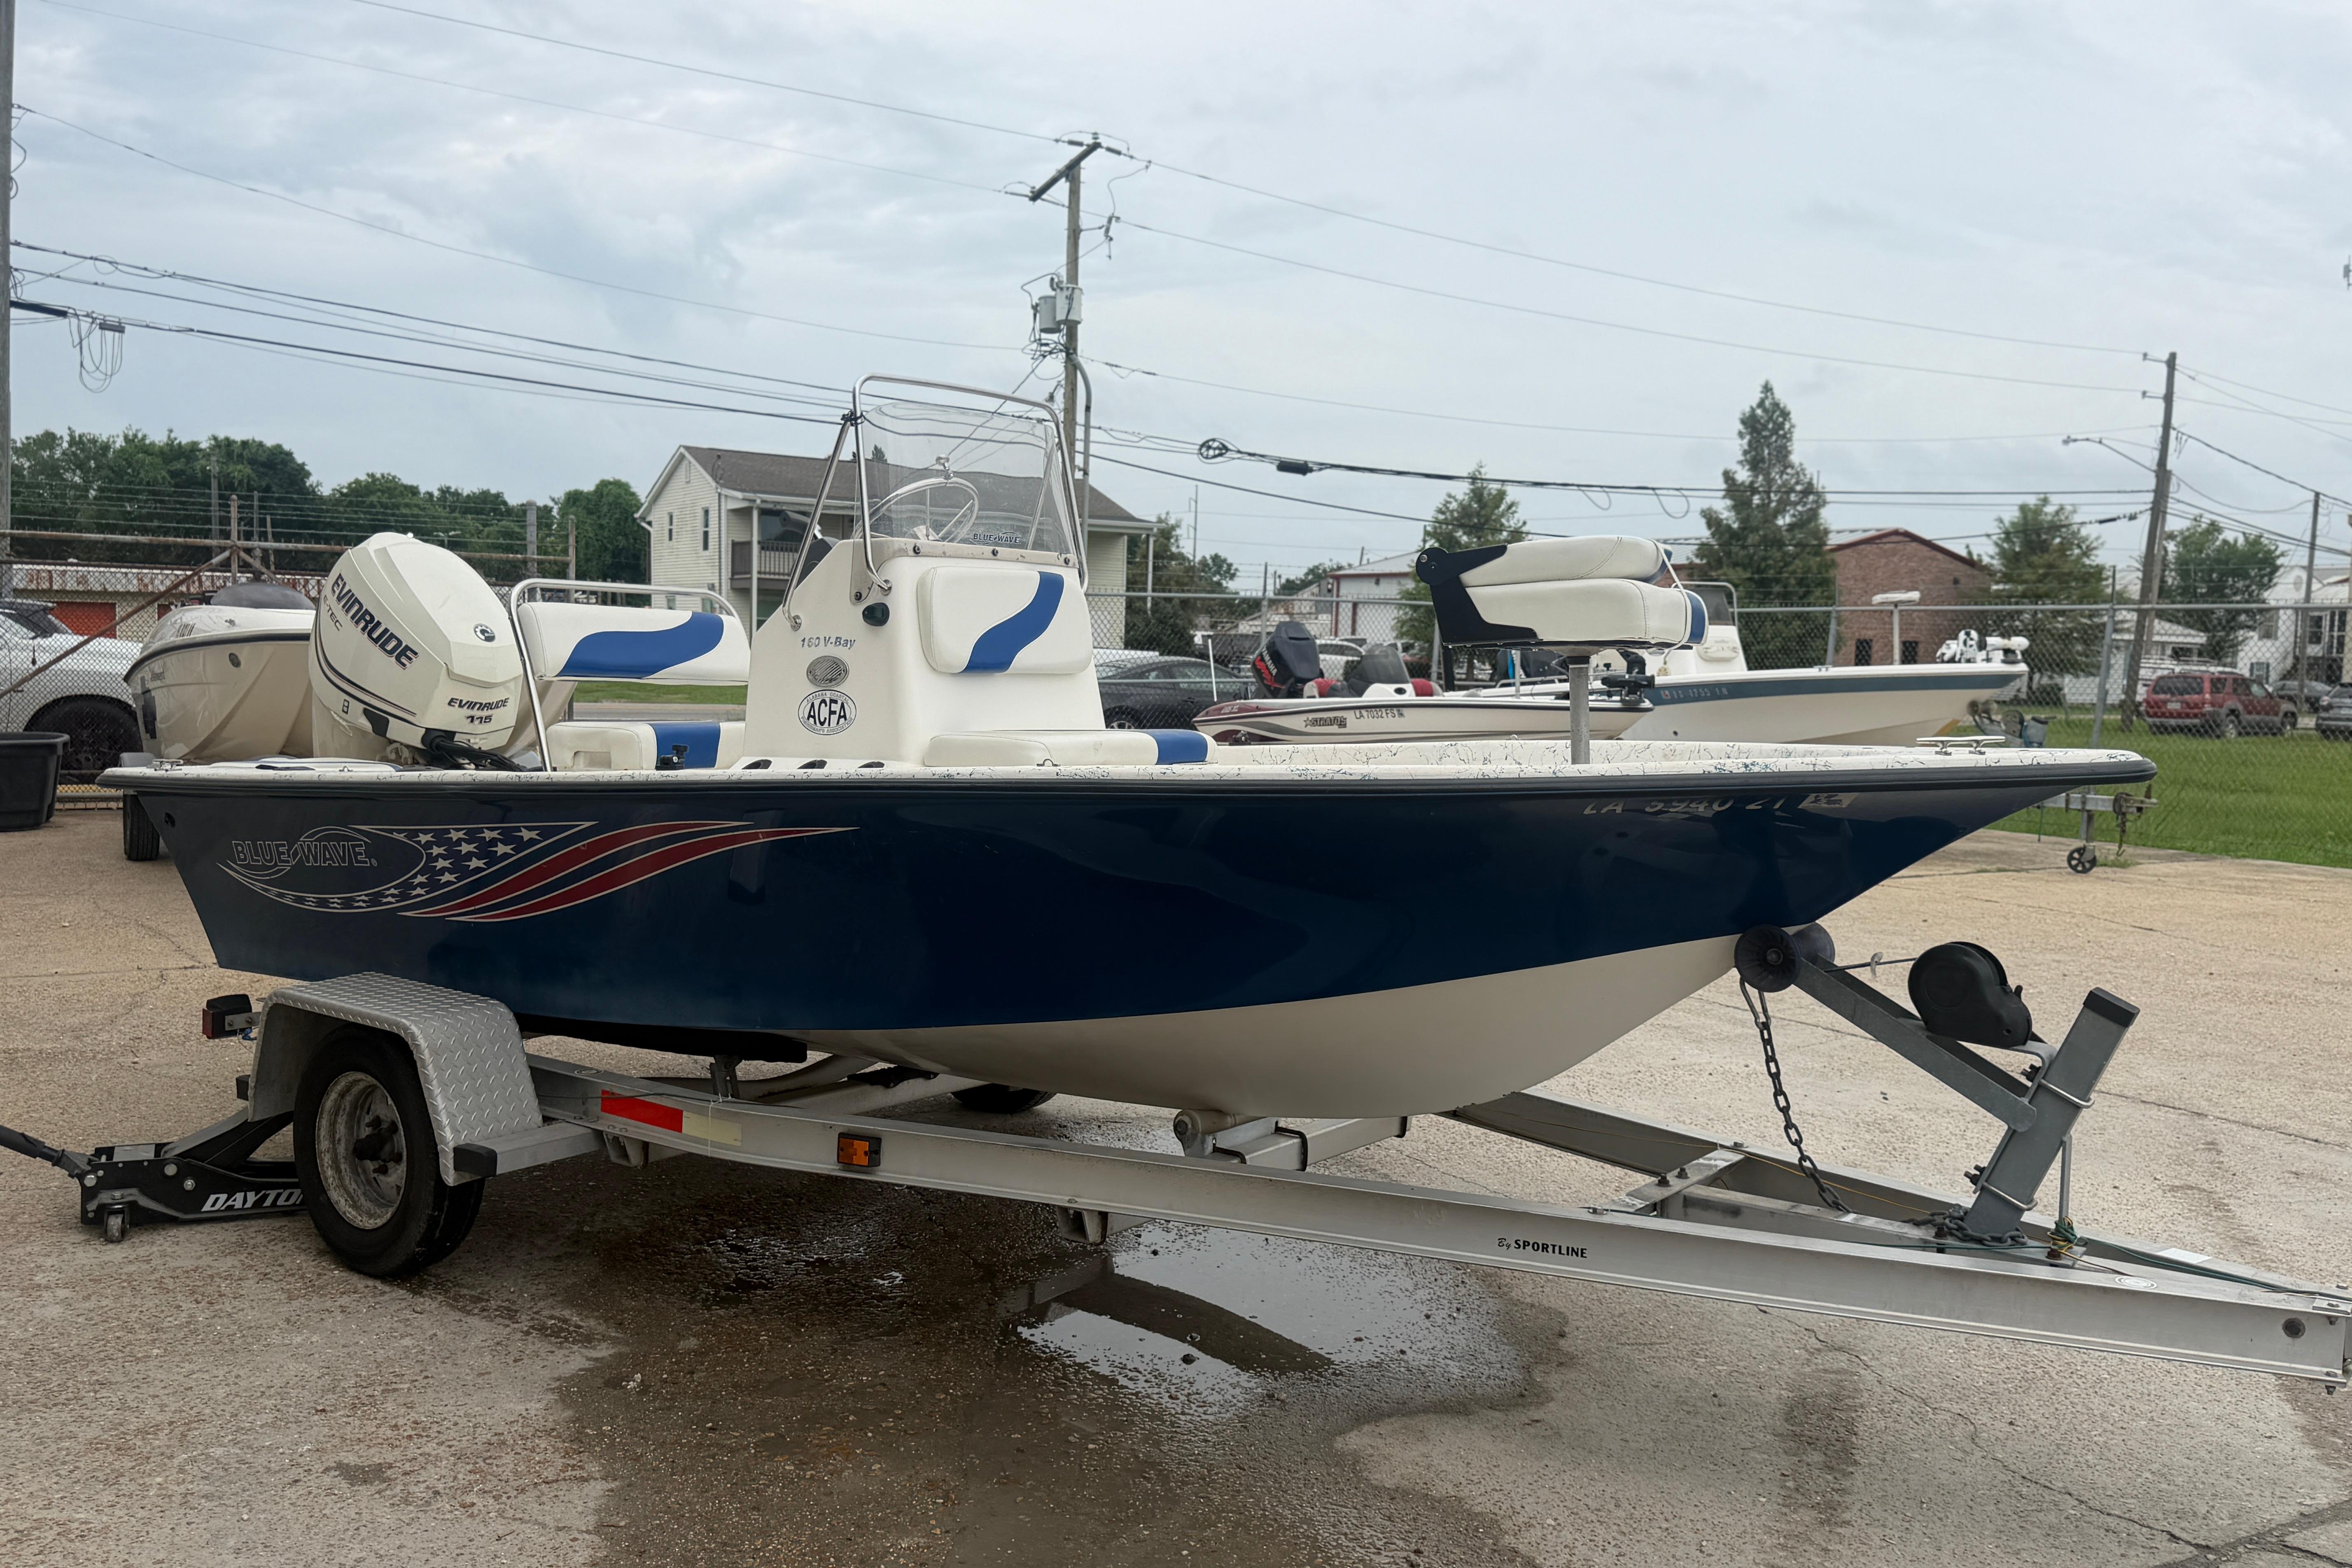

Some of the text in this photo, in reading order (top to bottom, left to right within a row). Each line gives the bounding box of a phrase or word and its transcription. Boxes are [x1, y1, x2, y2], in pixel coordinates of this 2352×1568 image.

[973, 533, 1020, 544] BLUE WAVE
[323, 595, 343, 631] E-TEC
[331, 573, 419, 670] EVINRUDE
[801, 636, 856, 650] 160 V-Bay
[1261, 645, 1277, 676] YAMAHA
[447, 697, 510, 712] EVINRUDE
[807, 698, 847, 727] ACFA
[465, 713, 493, 724] 115
[1311, 716, 1347, 727] STRATOS
[1353, 708, 1396, 719] LA 7032 FS
[1583, 798, 1626, 814] LA
[232, 841, 370, 866] BLUE WAVE
[1498, 1238, 1587, 1258] By SPORTLINE
